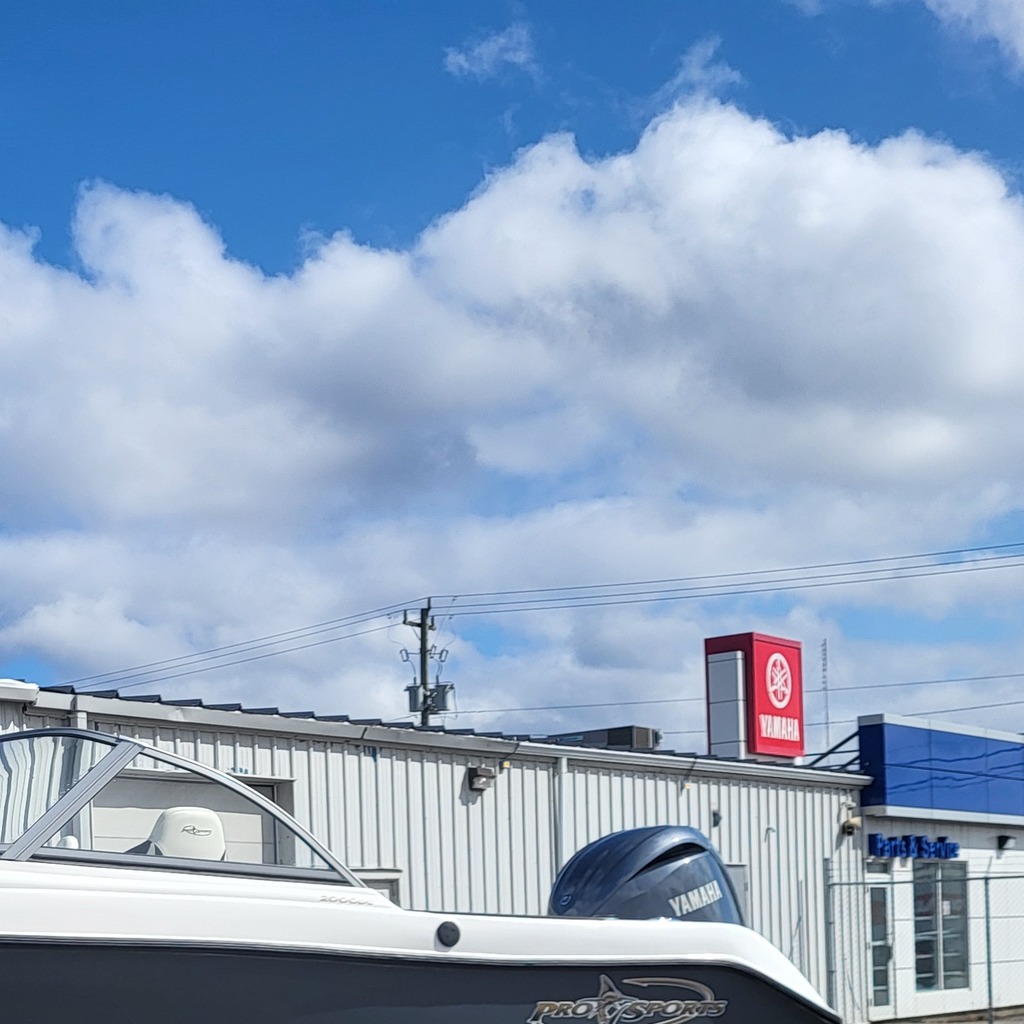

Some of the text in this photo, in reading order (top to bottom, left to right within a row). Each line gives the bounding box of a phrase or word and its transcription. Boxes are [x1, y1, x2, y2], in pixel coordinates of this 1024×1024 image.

[759, 714, 800, 742] YAMAHA
[869, 833, 907, 858] Parts
[920, 835, 960, 858] Service
[668, 880, 723, 917] YAMAHA
[619, 1001, 728, 1022] SPORTS
